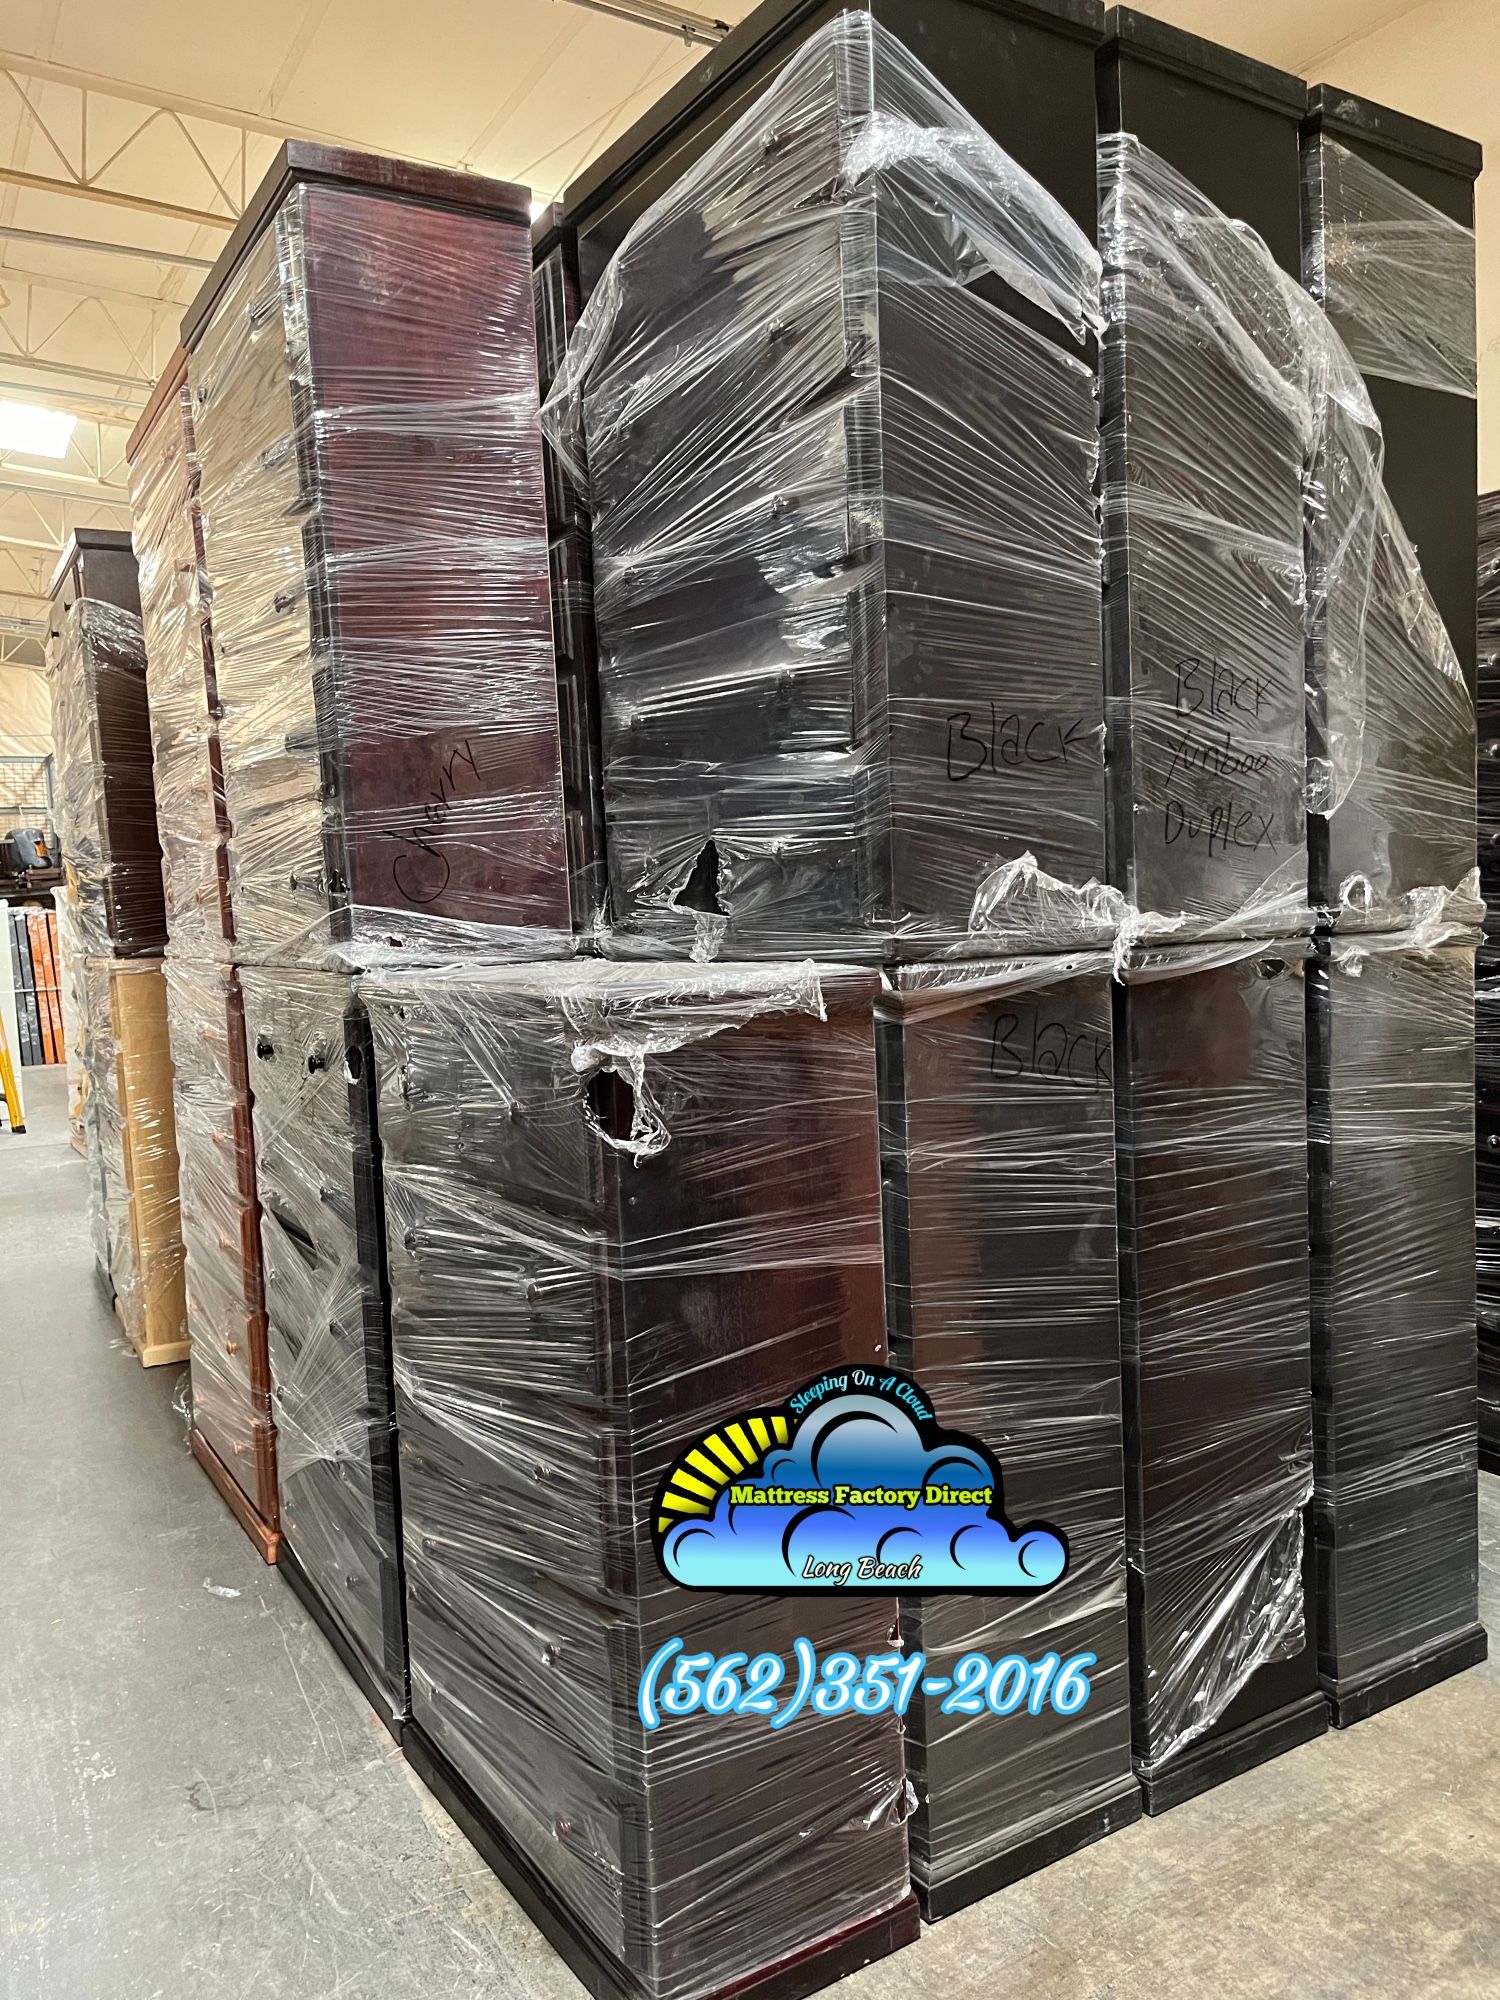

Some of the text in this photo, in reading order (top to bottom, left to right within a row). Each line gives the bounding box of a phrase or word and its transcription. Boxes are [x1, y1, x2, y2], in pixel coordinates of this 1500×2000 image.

[1174, 656, 1272, 719] Black
[946, 702, 1092, 782] Black
[1164, 800, 1278, 858] Duplex
[990, 1007, 1113, 1094] Black
